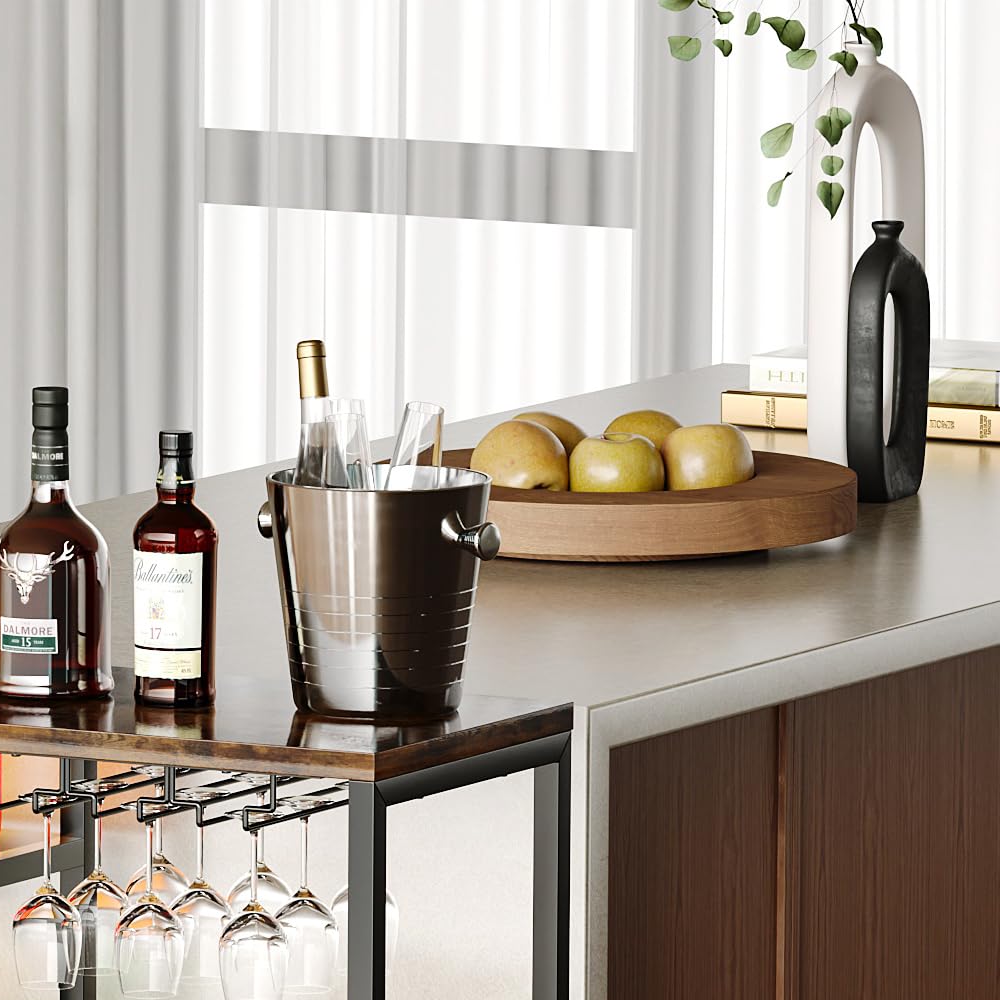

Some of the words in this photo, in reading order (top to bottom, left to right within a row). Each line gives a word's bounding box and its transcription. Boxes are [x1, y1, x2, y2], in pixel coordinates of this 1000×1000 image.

[3, 624, 53, 635] DALMORE
[150, 627, 162, 640] 17
[21, 637, 32, 647] 15
